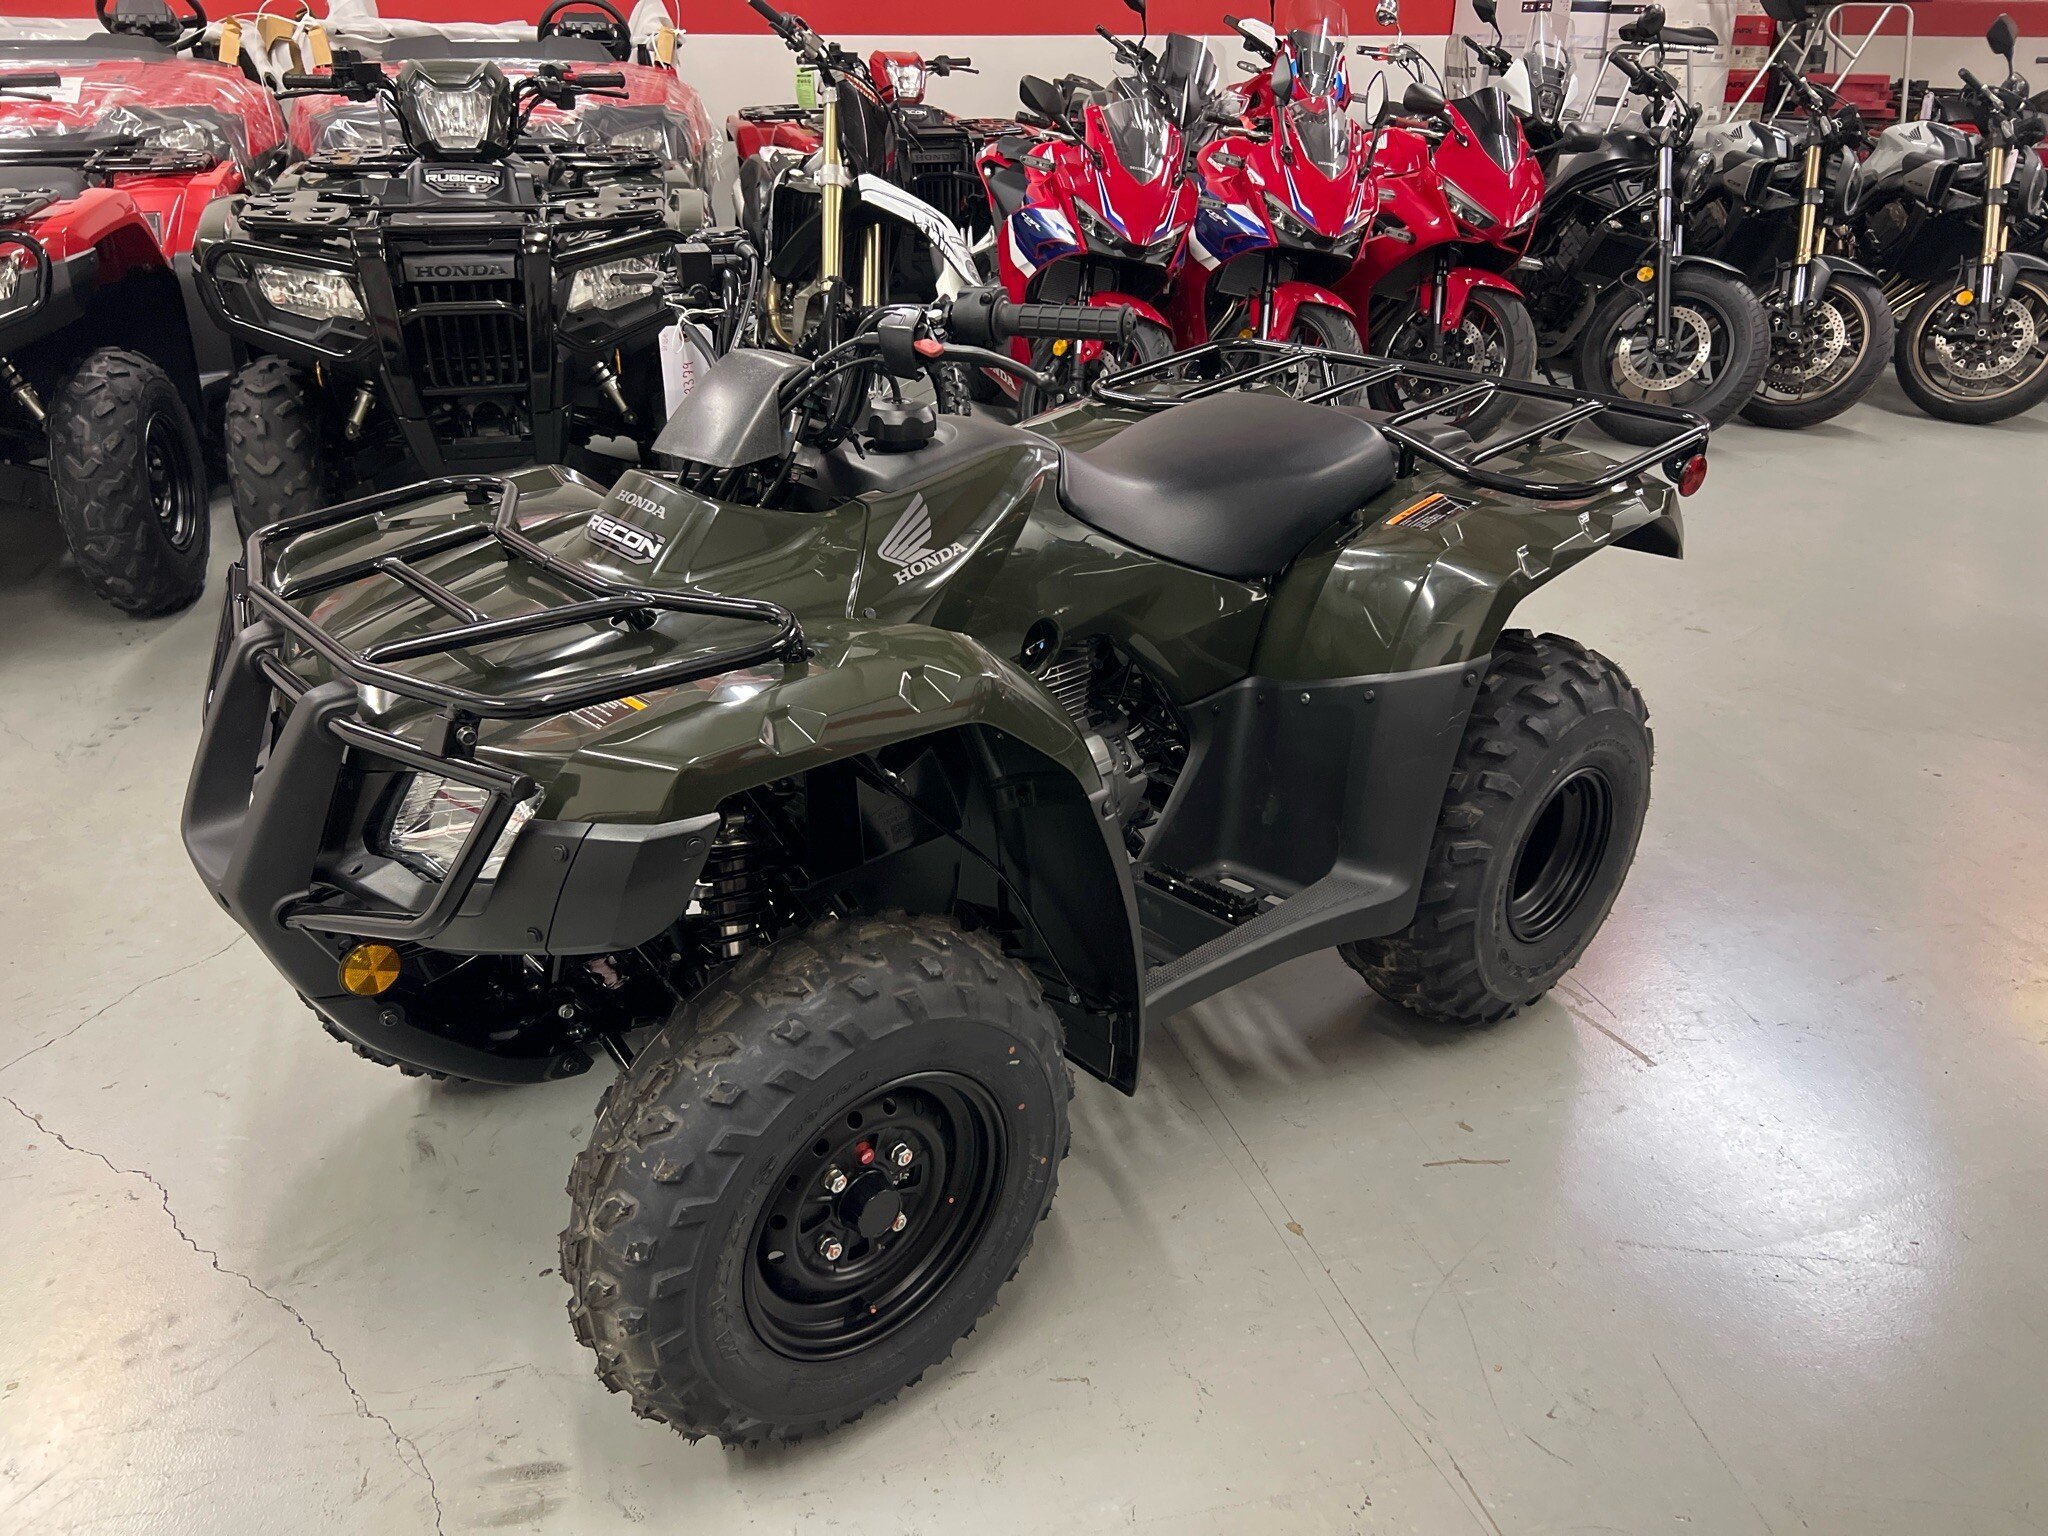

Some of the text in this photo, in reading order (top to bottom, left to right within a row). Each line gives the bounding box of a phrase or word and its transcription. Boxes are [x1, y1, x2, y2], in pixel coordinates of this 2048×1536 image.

[425, 173, 500, 185] RUBICON
[414, 263, 509, 279] HONDA
[615, 489, 667, 520] HONDA
[586, 514, 663, 559] RECON
[893, 542, 968, 586] HONDA
